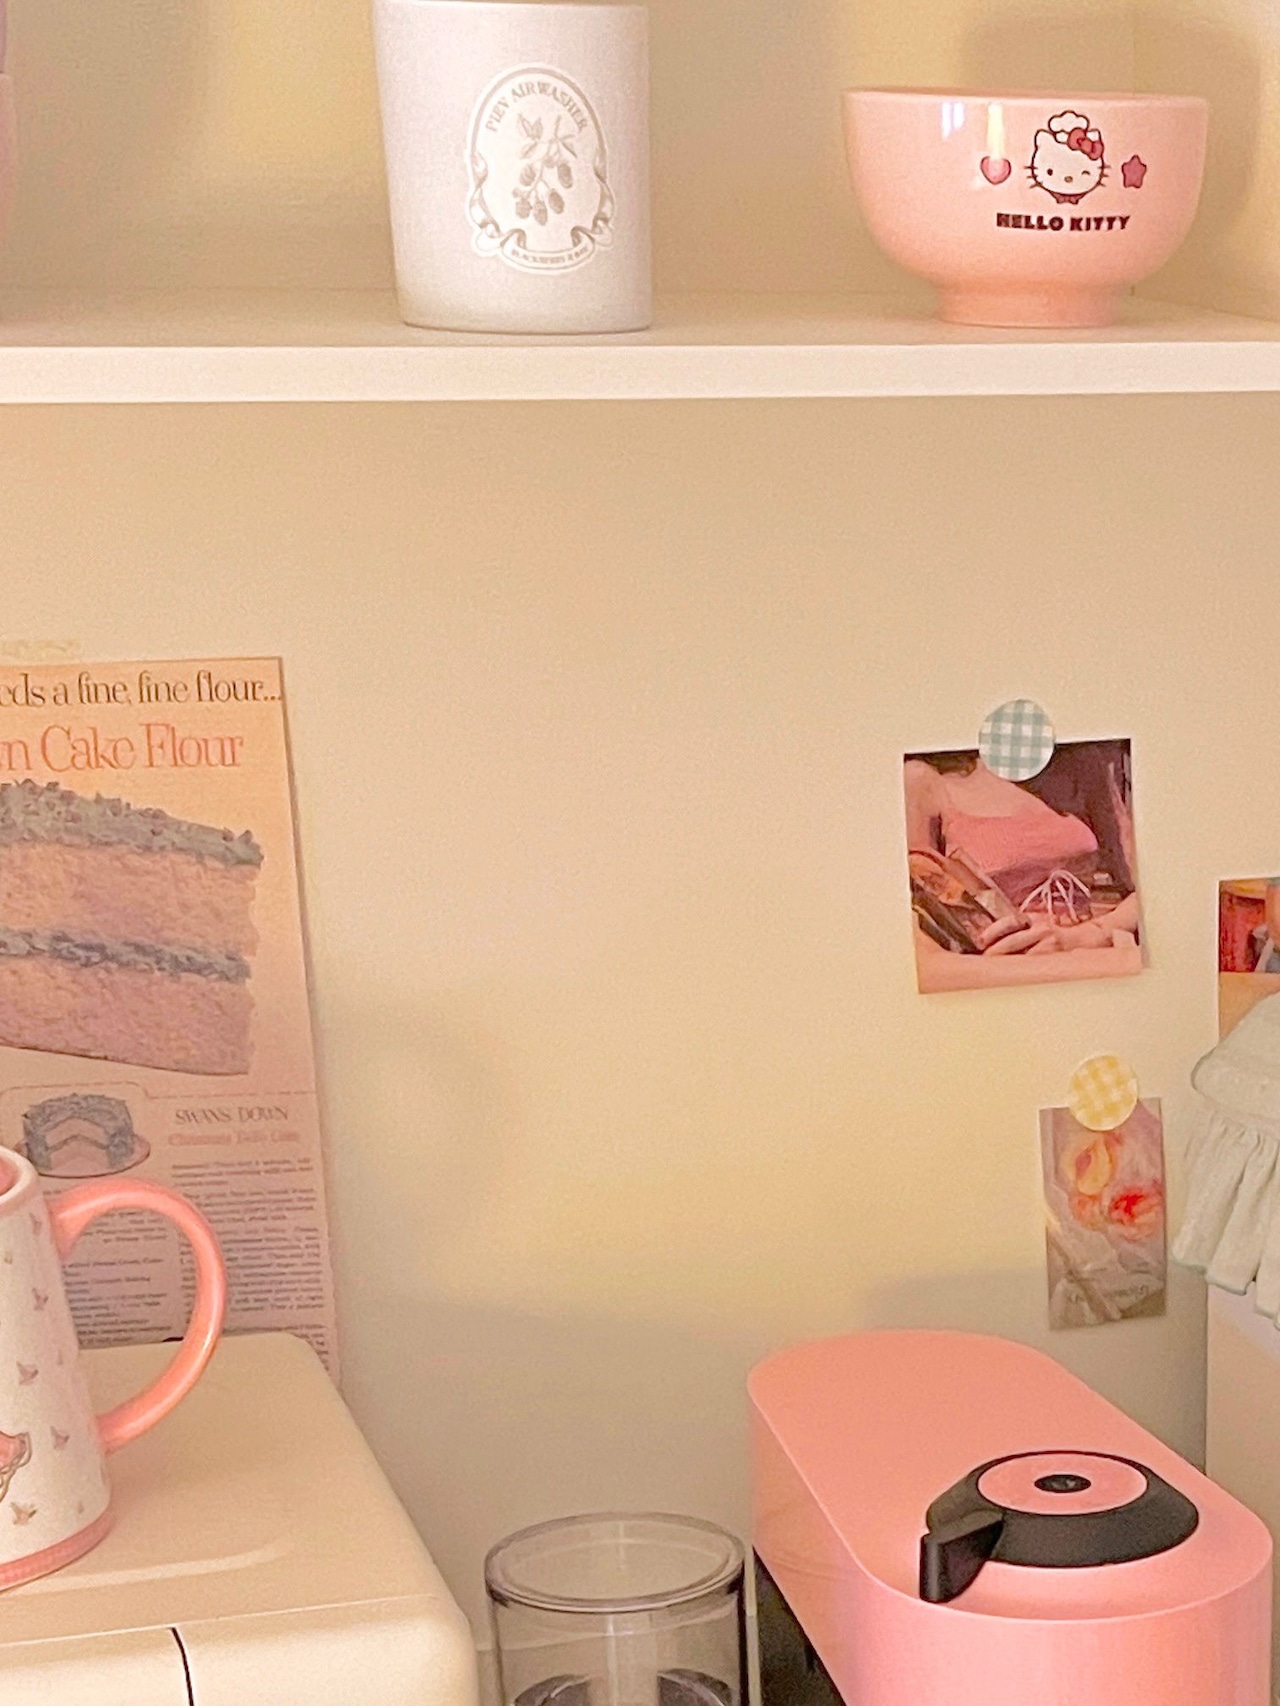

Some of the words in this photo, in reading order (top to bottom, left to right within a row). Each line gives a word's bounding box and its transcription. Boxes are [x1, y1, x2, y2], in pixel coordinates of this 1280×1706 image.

[996, 213, 1063, 231] HELLO
[1070, 215, 1130, 231] KITTY
[53, 682, 69, 706] a
[78, 670, 132, 705] fine,
[139, 670, 189, 702] fine
[197, 669, 282, 702] flour...
[41, 724, 136, 773] Cake
[140, 722, 244, 768] Flour
[175, 1107, 232, 1124] SWANS
[237, 1105, 289, 1122] DOWN
